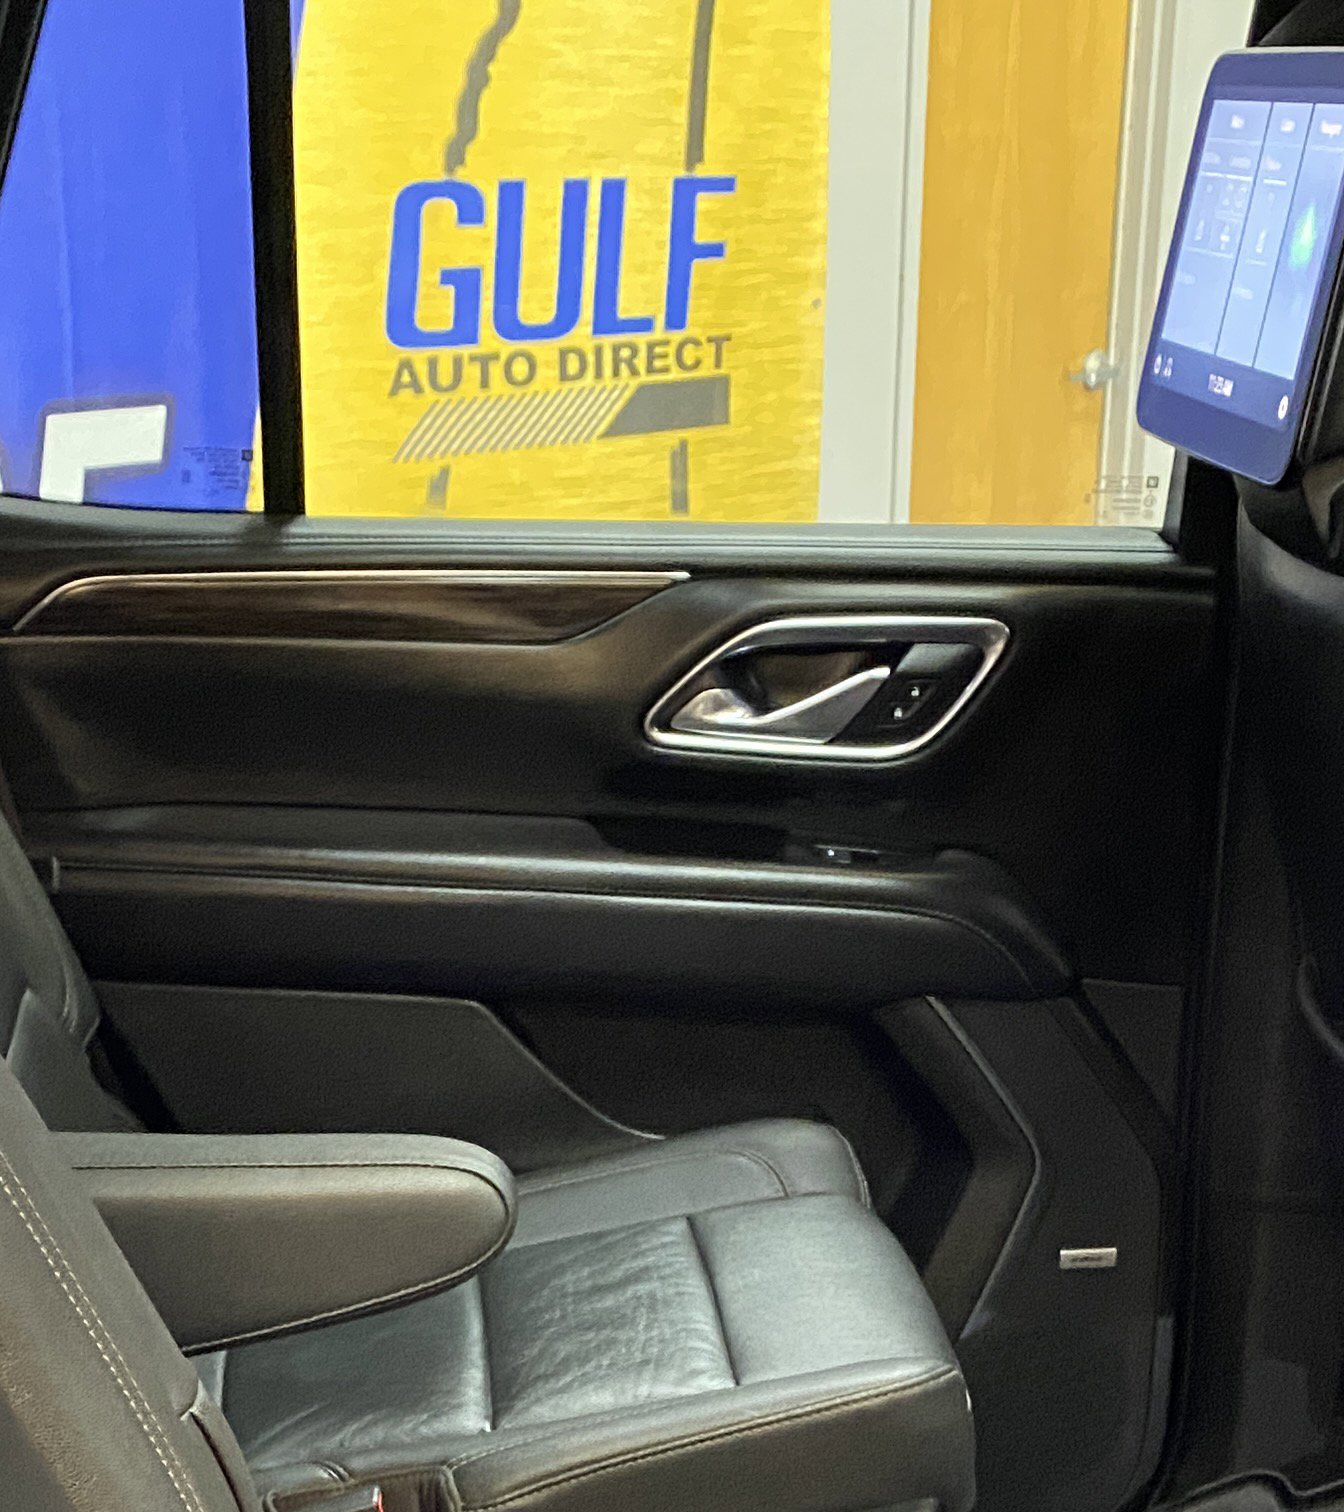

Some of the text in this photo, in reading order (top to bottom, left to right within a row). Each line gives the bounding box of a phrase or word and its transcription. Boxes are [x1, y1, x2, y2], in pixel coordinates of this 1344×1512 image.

[385, 176, 737, 349] GULF
[388, 334, 732, 399] AUTO DIRECT
